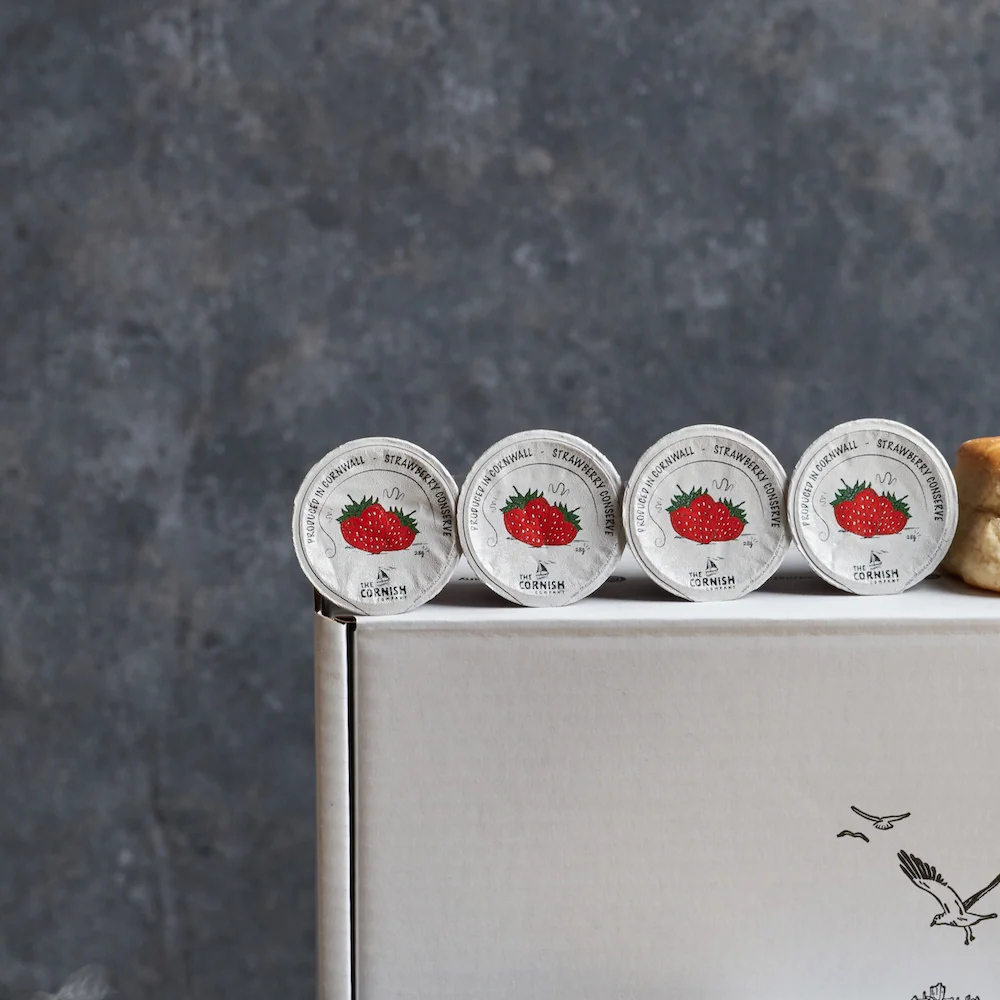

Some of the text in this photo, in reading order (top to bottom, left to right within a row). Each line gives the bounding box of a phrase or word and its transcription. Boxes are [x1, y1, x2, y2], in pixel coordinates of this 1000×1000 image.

[305, 454, 452, 544] PRODUCED IN CORNWALL STRAWBERRY CONSERVE
[471, 448, 615, 537] PRODUCED IN CORNWALL STRAWBERRY CONSERVE
[636, 444, 781, 533] PRODUCED IN CORNWALL STRAWBERRY CONSERVE
[800, 439, 944, 527] PRODUCED IN CORNWALL STRAWBERRY CONSERVE
[360, 585, 407, 598] CORNISH
[519, 580, 565, 590] CORNISH
[689, 576, 735, 587] CORNISH
[853, 569, 899, 581] CORNISH
